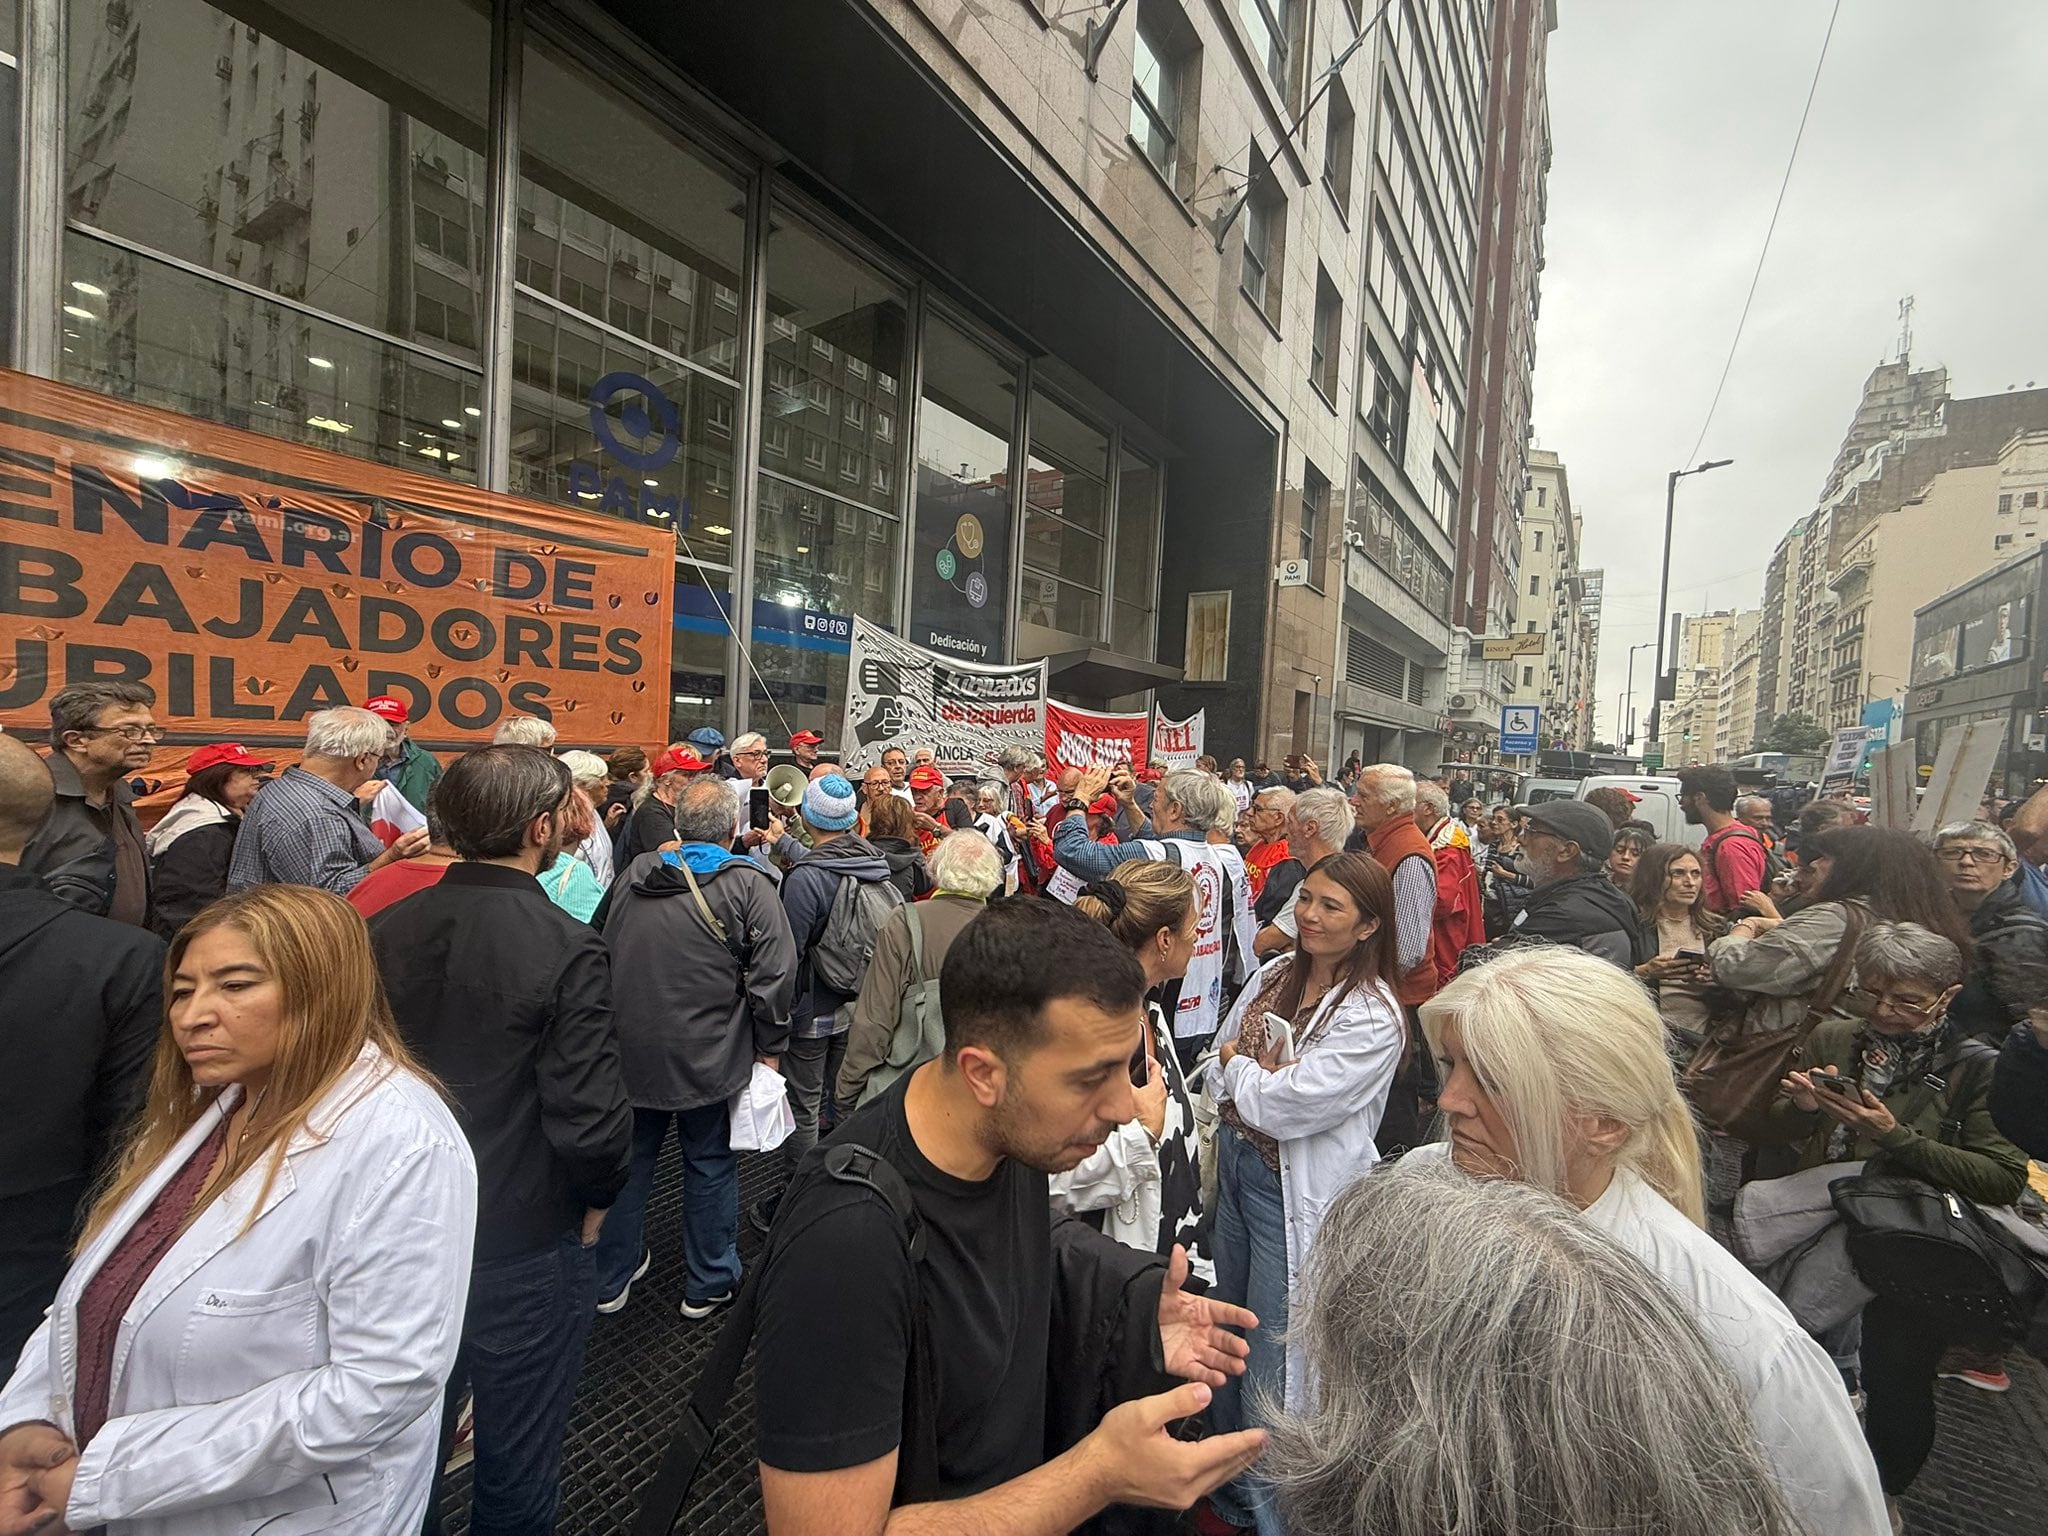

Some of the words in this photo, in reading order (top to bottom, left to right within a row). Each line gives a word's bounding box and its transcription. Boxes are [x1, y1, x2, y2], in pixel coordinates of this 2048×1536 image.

[570, 463, 690, 532] PAMI
[226, 508, 360, 544] pami.org.ar
[493, 547, 597, 610] DE
[0, 541, 643, 675] BAJADORES
[930, 632, 980, 653] Dedicación
[981, 644, 987, 657] y
[1514, 635, 1541, 652] Hotel
[941, 699, 963, 721] de
[966, 702, 1036, 729] izquierda
[935, 744, 974, 761] ANCLA
